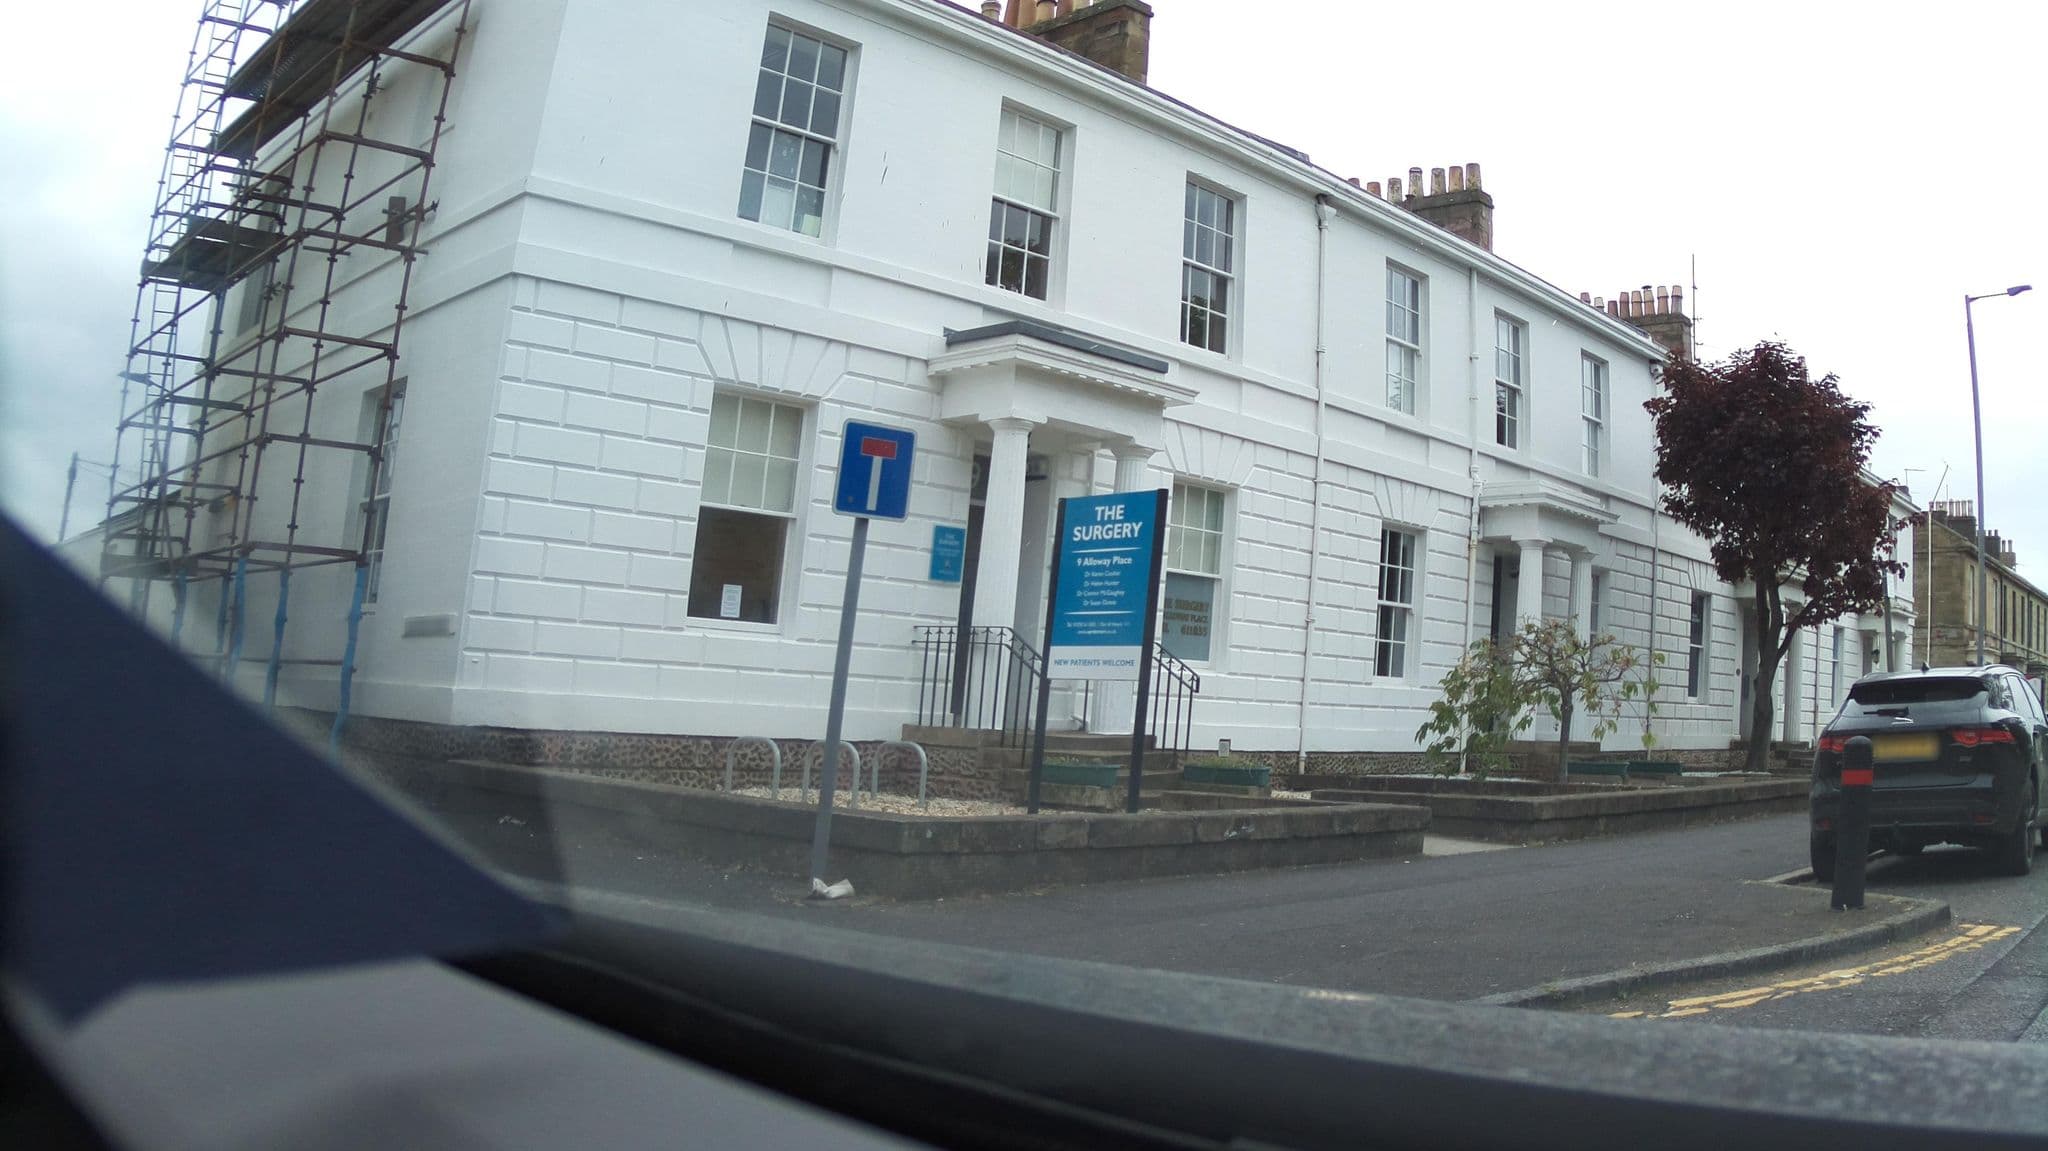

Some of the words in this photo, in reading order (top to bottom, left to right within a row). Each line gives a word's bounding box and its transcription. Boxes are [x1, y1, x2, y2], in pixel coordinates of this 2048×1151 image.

[1095, 504, 1125, 521] THE
[1073, 521, 1143, 541] SURGERY
[1077, 558, 1082, 566] 9
[1083, 556, 1111, 567] Alloway
[1112, 556, 1133, 565] Place
[1190, 614, 1209, 624] PLACE
